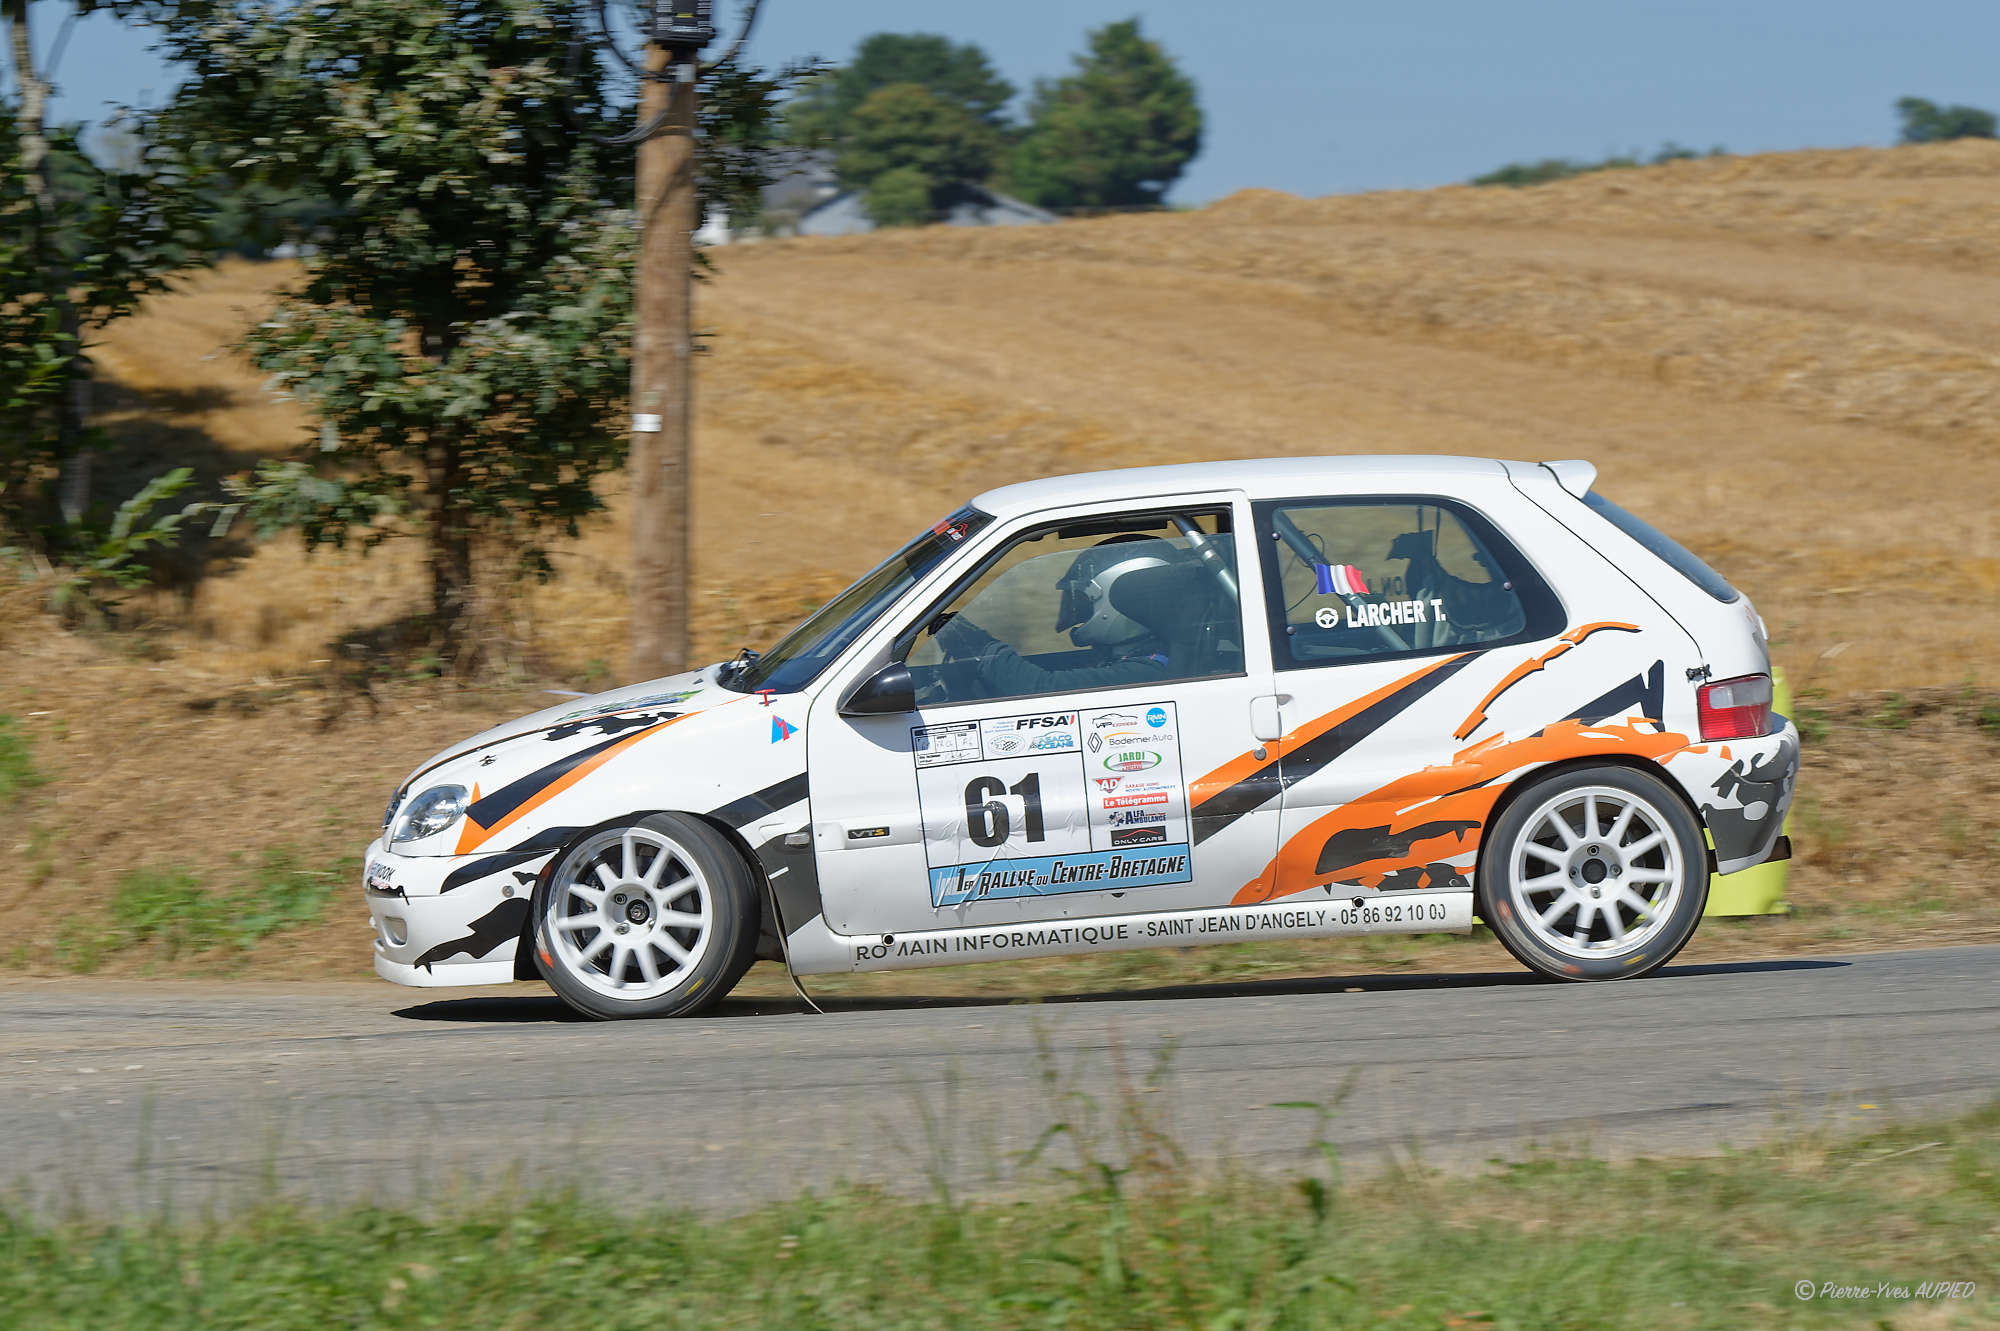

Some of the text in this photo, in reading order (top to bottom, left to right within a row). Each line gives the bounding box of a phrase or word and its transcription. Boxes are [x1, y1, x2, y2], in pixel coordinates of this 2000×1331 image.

[1346, 598, 1446, 628] LARCHER T.
[1016, 715, 1069, 730] FFSA
[1101, 779, 1118, 790] AD
[1104, 795, 1167, 807] Le Télégramme
[964, 772, 1046, 848] 61
[851, 828, 885, 838] VTS
[1113, 835, 1164, 845] ONLY CARS
[978, 869, 1036, 896] RALLYE
[1036, 875, 1049, 885] DU
[1050, 855, 1186, 884] CENTRE-BRETAGNE
[955, 924, 1129, 952] INFORMATIQUE
[1146, 918, 1194, 937] SAINT
[1198, 914, 1241, 933] JEAN
[1246, 910, 1326, 930] D'ANGELY
[1341, 909, 1358, 925] 05
[1363, 907, 1380, 923] 86
[1384, 905, 1401, 922] 92
[1407, 904, 1424, 920] 10
